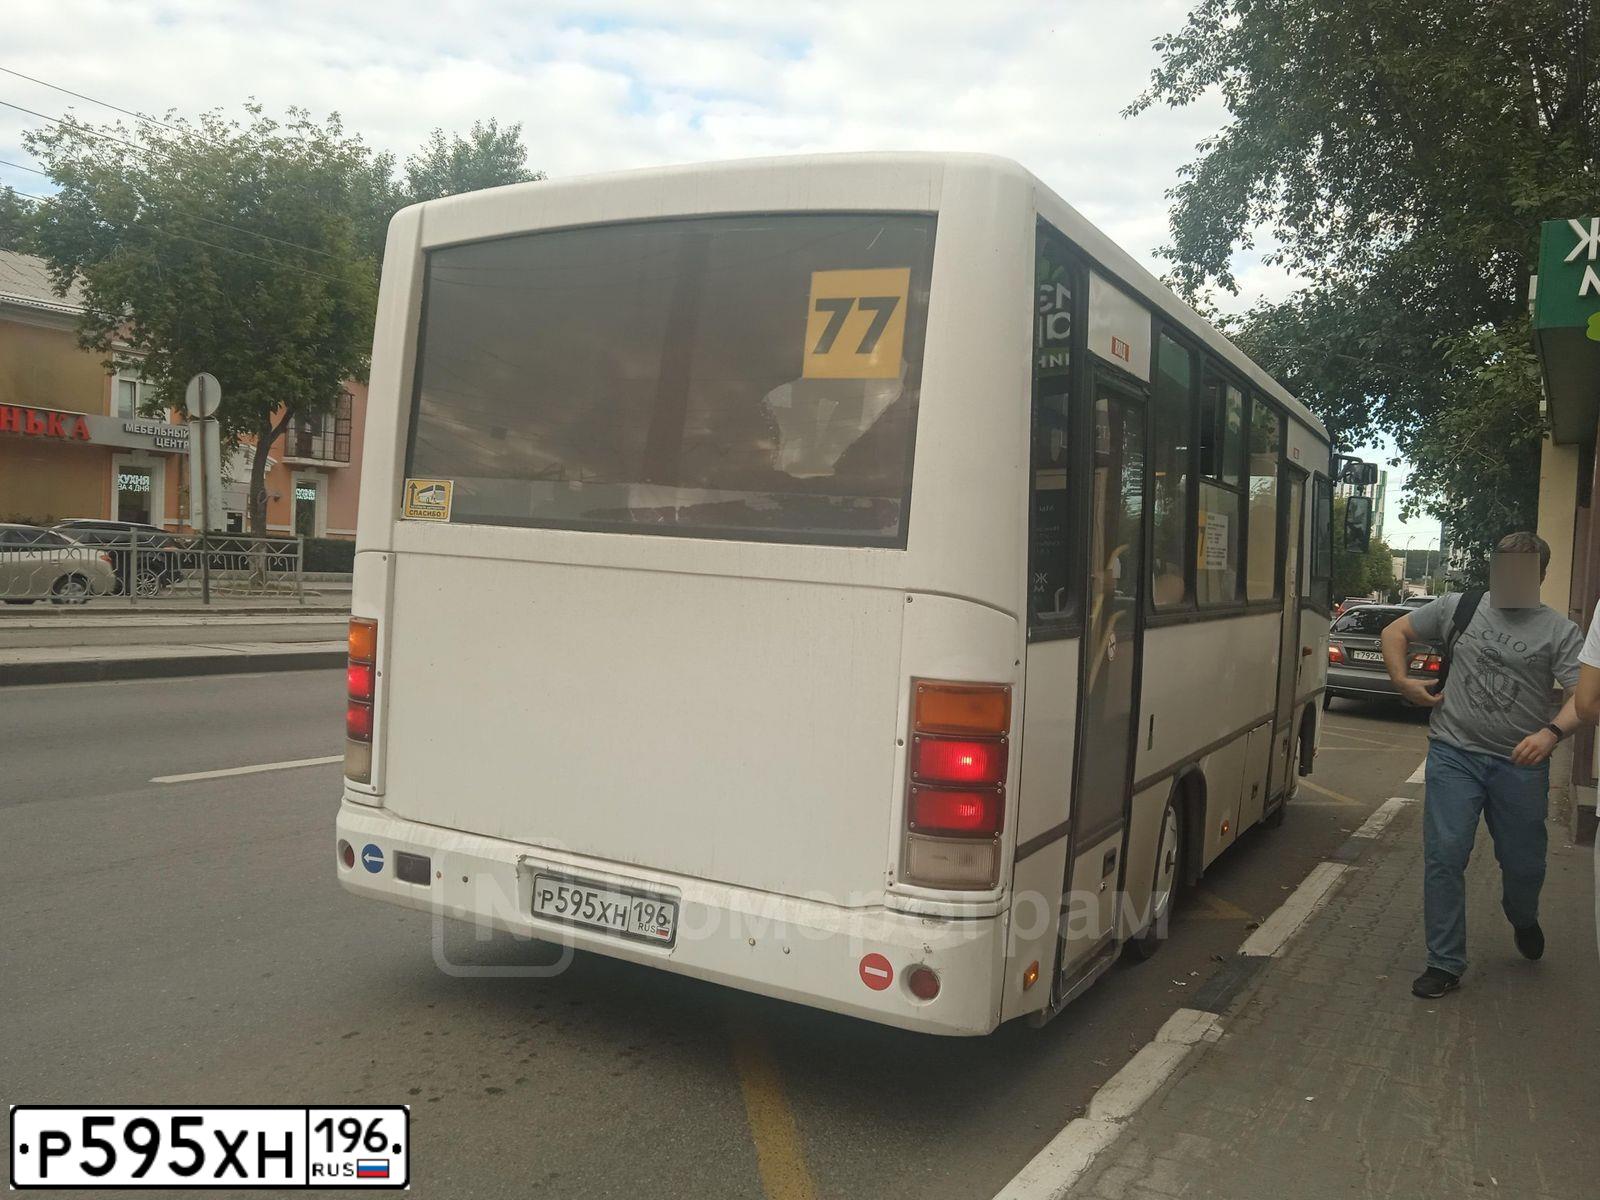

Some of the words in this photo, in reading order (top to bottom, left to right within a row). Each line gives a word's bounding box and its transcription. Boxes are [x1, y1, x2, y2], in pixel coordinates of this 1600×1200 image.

[812, 296, 901, 354] 77
[156, 437, 190, 449] ЦЕНТР
[117, 473, 150, 485] КУХНЯ
[540, 886, 628, 927] Р595ХН
[633, 901, 668, 927] 196
[637, 922, 656, 934] RUS
